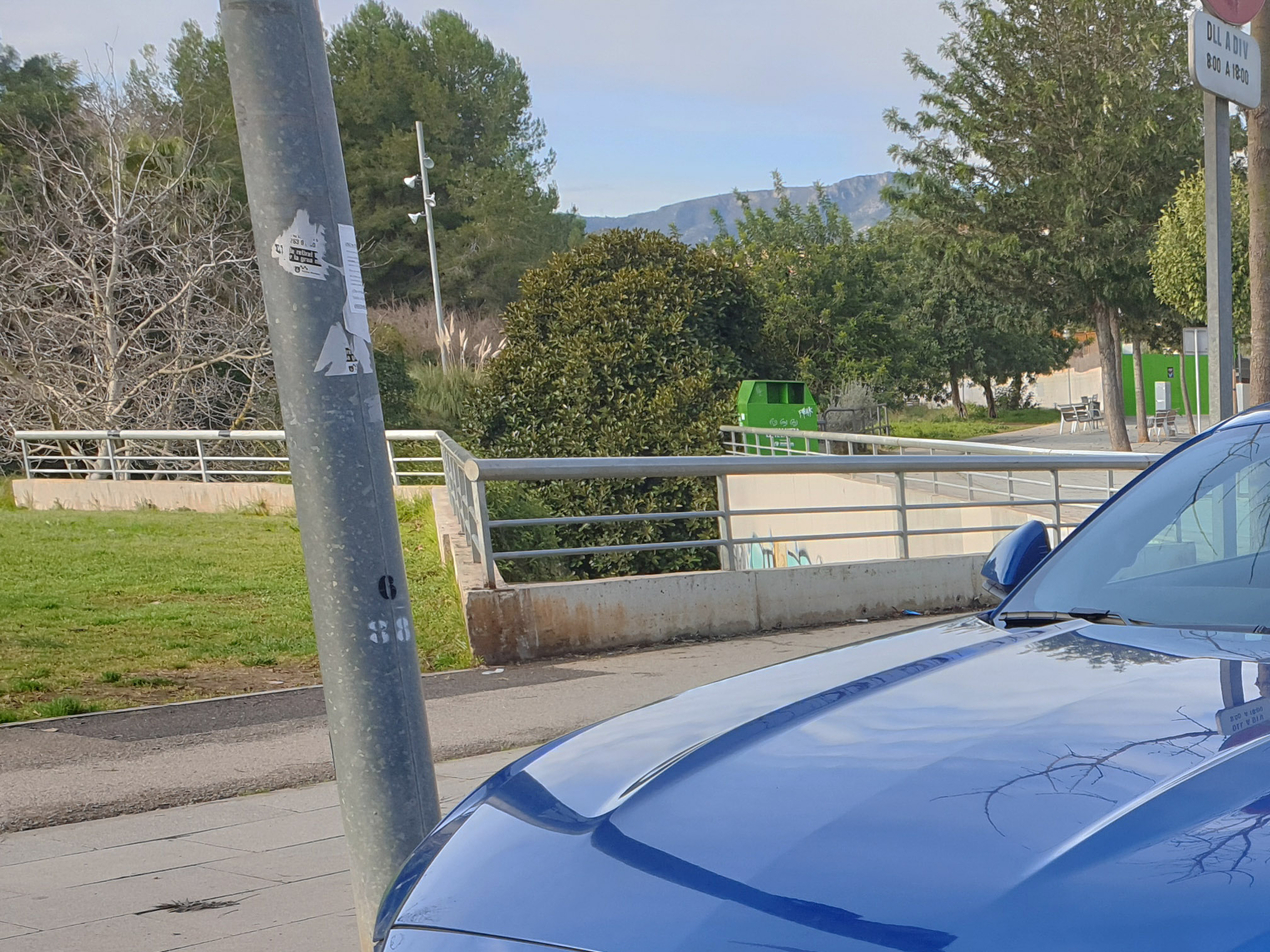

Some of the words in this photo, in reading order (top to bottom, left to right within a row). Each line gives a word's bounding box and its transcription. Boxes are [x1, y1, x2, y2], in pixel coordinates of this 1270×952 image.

[1207, 20, 1222, 46] DLL
[1225, 30, 1231, 52] A
[1232, 34, 1249, 60] DIV
[1225, 60, 1231, 78] A
